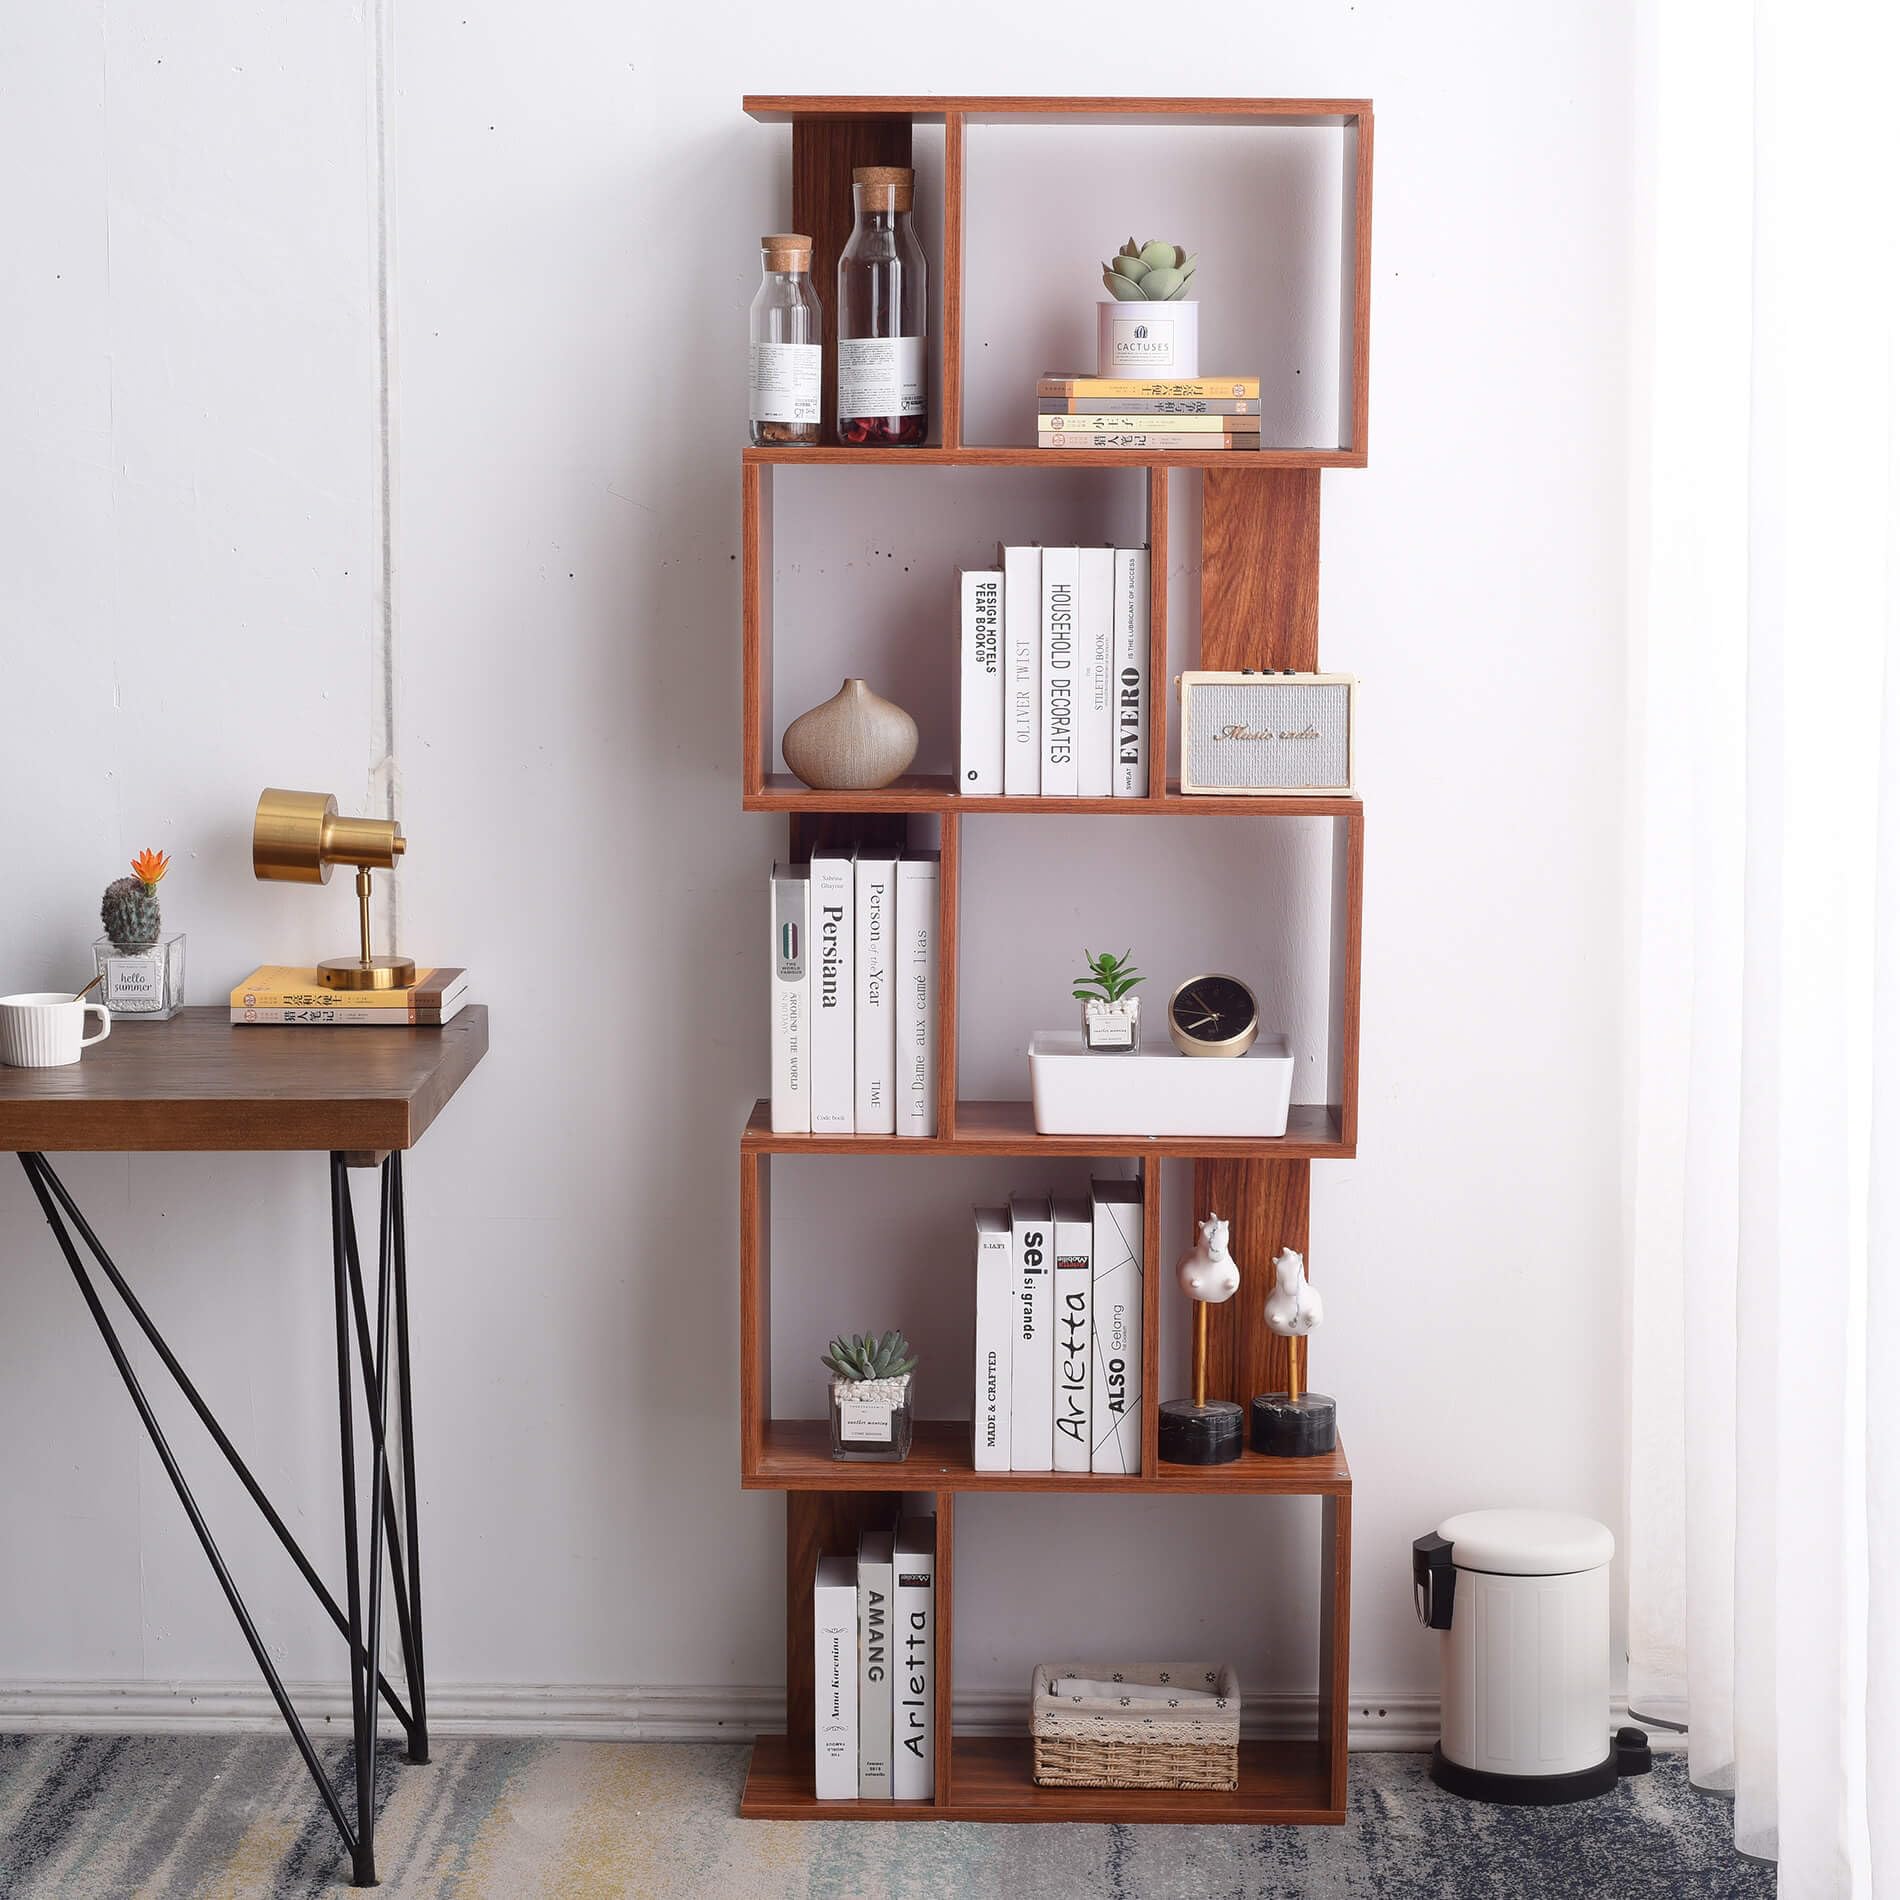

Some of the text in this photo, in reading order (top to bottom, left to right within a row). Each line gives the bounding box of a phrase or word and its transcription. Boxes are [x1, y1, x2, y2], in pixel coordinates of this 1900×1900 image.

[1117, 343, 1169, 352] CACTUSES
[976, 583, 986, 613] YEAR
[986, 583, 997, 674] DESIGN HOTELS
[1129, 590, 1135, 599] OF
[1016, 639, 1031, 743] OLIVER TWIST
[1051, 584, 1071, 764] HOUSEHOLD DECORATES
[1095, 633, 1104, 711] STILETTO BOOK
[1119, 667, 1140, 765] EVERO
[114, 984, 152, 993] summer
[121, 972, 145, 983] hello
[822, 906, 844, 1008] Persiana
[868, 884, 884, 1007] Person of the Year
[790, 992, 798, 1091] AROUND THE WORLD
[911, 930, 927, 1117] La Dame aux camé lias
[870, 1080, 881, 1108] TIME
[1021, 1232, 1048, 1341] sei si grande
[987, 1351, 997, 1448] MADE & CRAFTED
[1056, 1292, 1085, 1443] Arletta
[1109, 1304, 1126, 1414] ALSO Gelang
[832, 1637, 840, 1721] Anna Karenina
[868, 1590, 885, 1683] AMANG
[903, 1611, 926, 1759] Arletta
